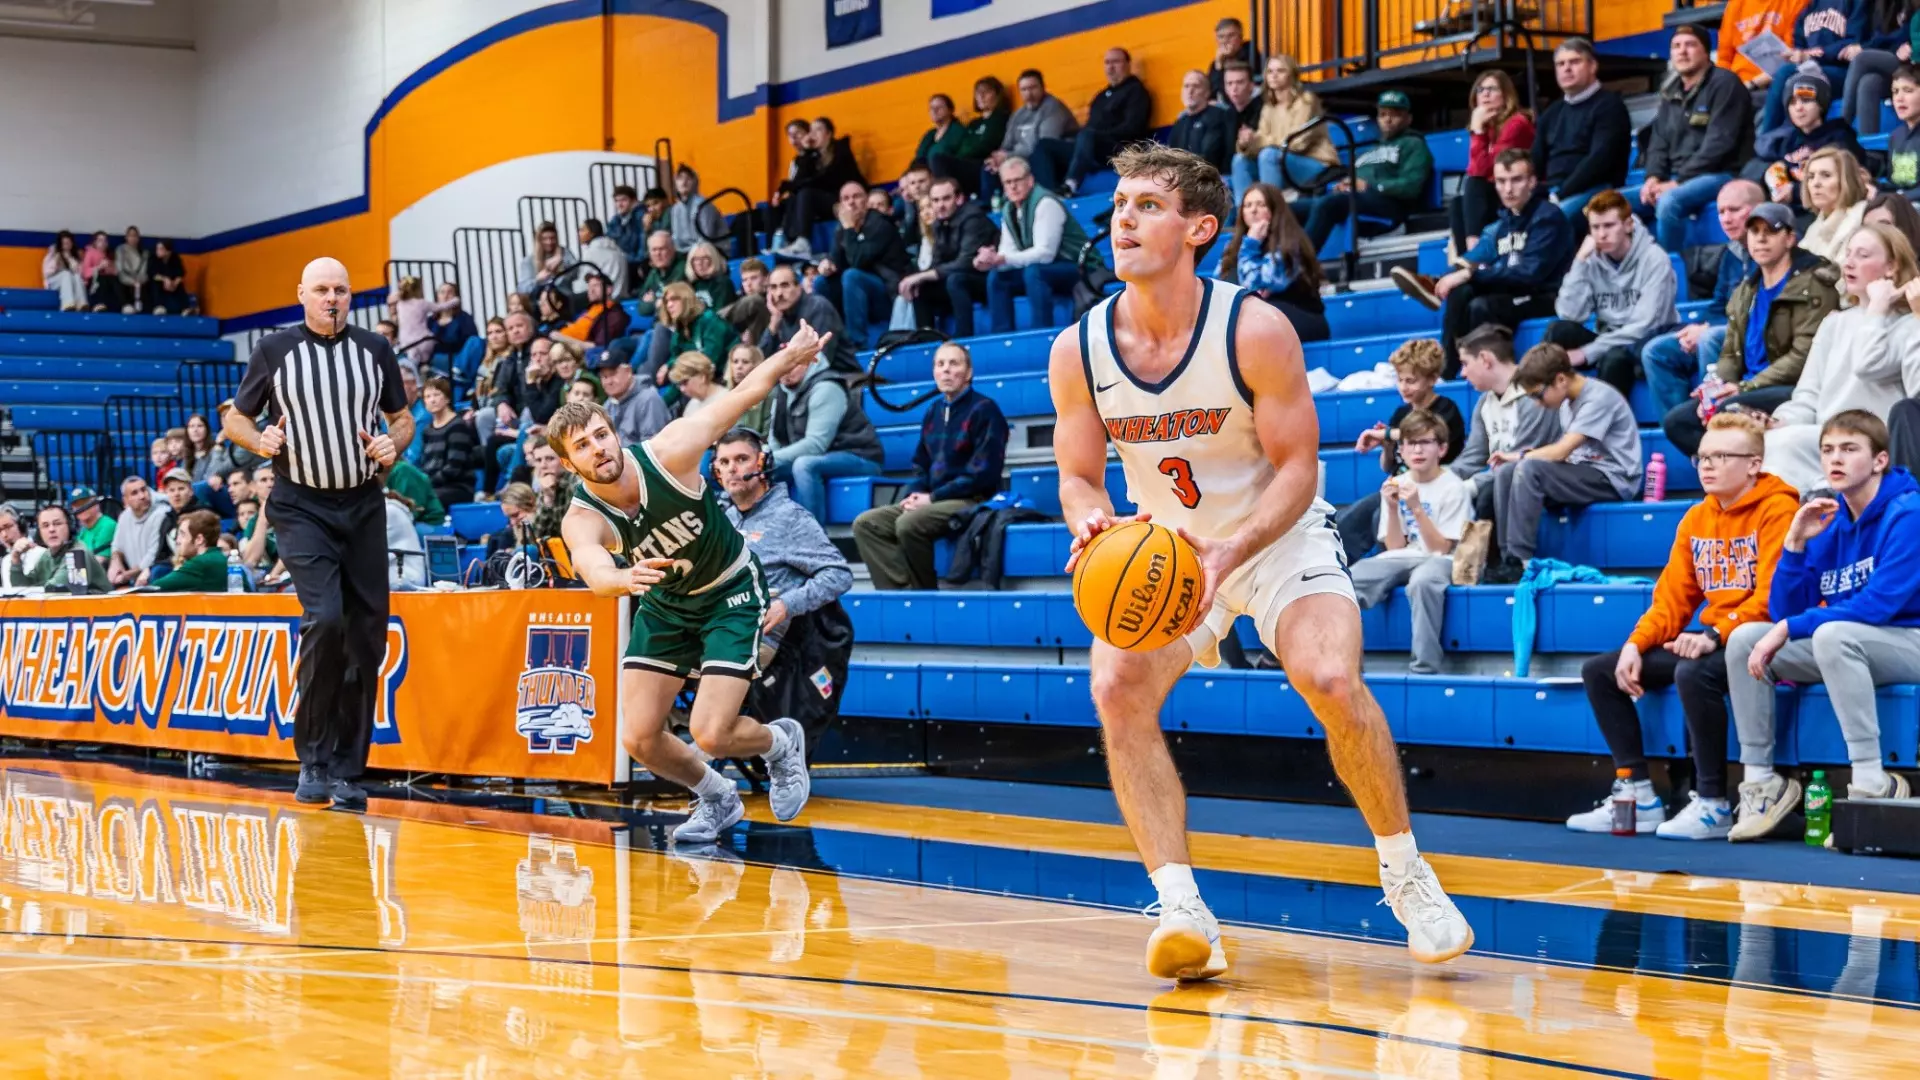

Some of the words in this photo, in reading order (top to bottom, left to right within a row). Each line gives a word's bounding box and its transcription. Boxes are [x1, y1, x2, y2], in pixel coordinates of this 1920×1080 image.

[1105, 408, 1232, 443] WHEATON
[1158, 457, 1202, 509] 3
[726, 591, 751, 608] IWU
[1116, 552, 1168, 634] Wilson
[1161, 577, 1195, 636] NCAA
[528, 612, 592, 623] WHEATON
[518, 670, 595, 712] THUNDER
